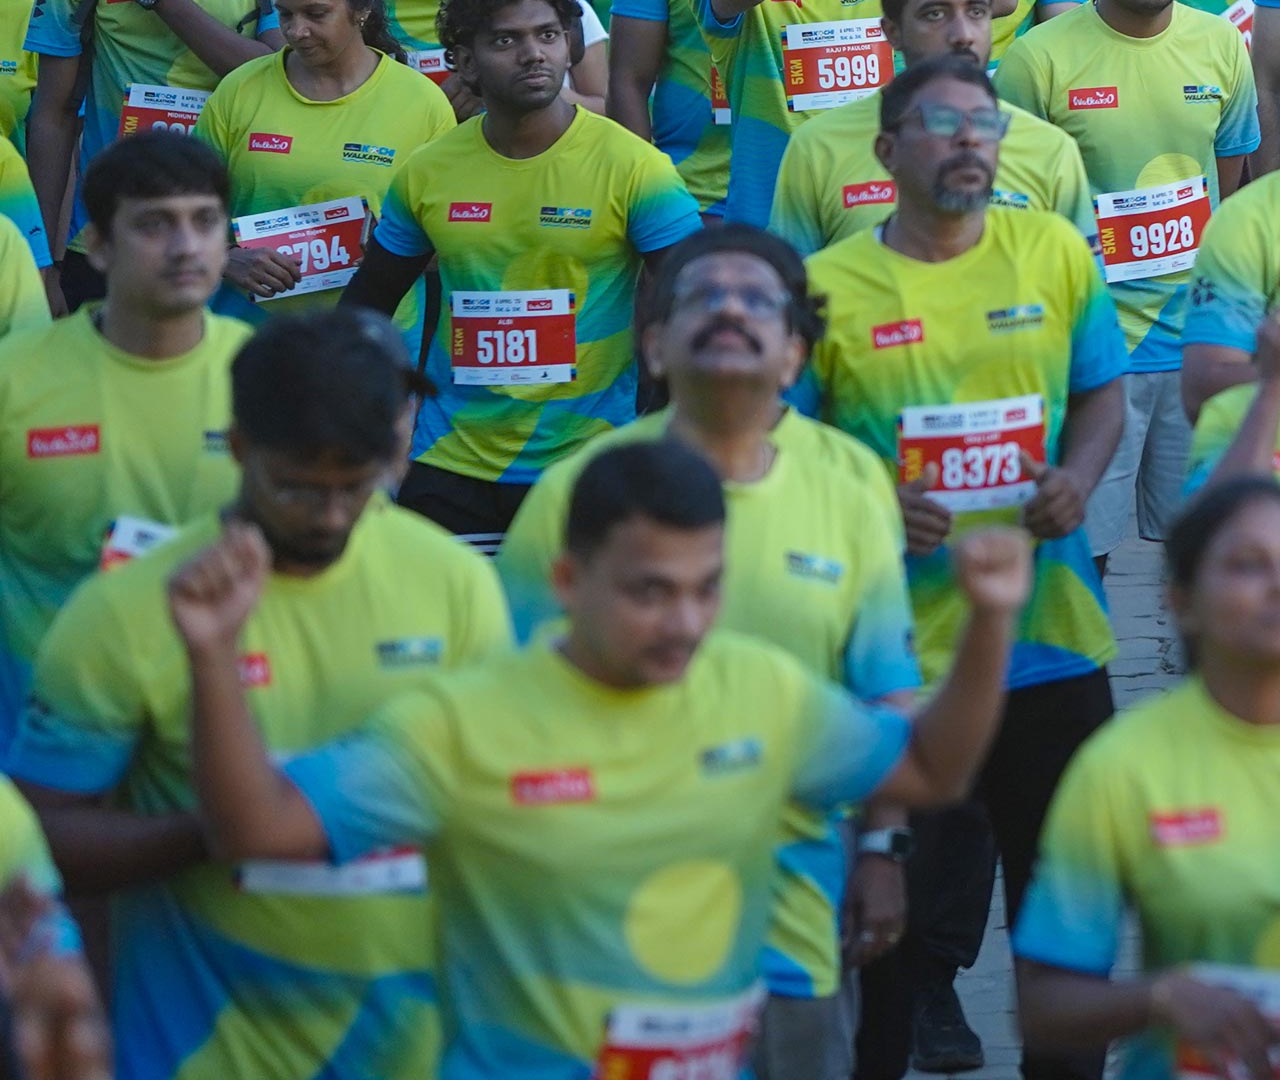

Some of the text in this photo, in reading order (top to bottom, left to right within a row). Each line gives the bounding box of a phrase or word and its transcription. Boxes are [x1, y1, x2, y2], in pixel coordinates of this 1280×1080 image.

[791, 58, 804, 86] 5KM
[817, 53, 880, 89] 5999
[1102, 227, 1117, 255] 5KM
[1130, 216, 1194, 257] 9928
[477, 329, 538, 365] 5181
[942, 441, 1021, 489] 8373
